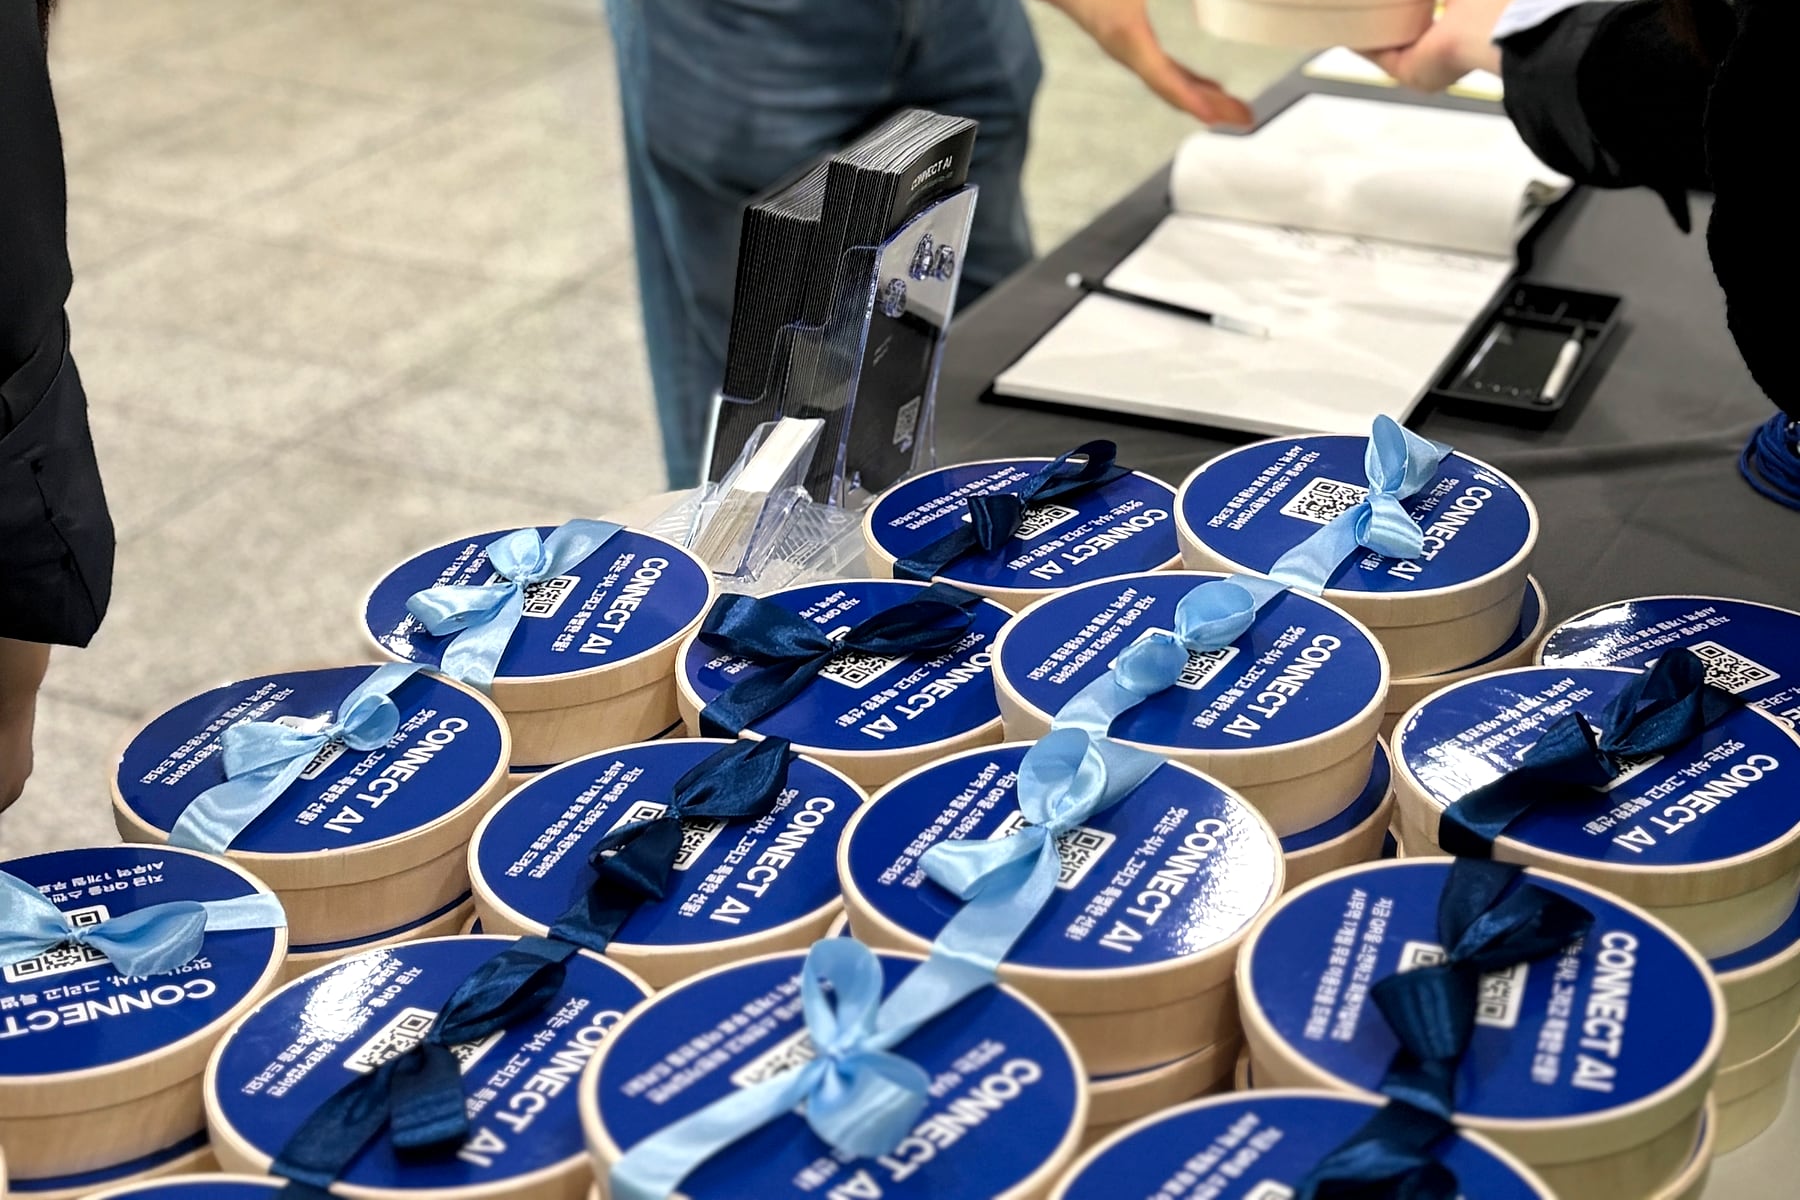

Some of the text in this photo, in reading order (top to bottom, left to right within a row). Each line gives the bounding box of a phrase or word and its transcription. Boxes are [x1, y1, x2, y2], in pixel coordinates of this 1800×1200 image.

[1285, 462, 1307, 477] QR을
[1030, 509, 1168, 580] CONNECT AI
[1060, 525, 1093, 541] 그리고
[464, 558, 485, 573] QR을
[1389, 557, 1424, 577] AI
[579, 558, 669, 654] CONNECT AI
[582, 589, 607, 610] 그리고
[814, 609, 841, 623] QR을
[1116, 609, 1141, 626] QR을
[1679, 623, 1709, 635] QR을
[894, 668, 929, 689] 그리고
[1223, 635, 1341, 738] CONNECT AI
[1235, 665, 1266, 688] 그리고
[1541, 699, 1573, 714] QR을
[860, 715, 897, 739] AI
[350, 749, 385, 776] 그리고
[324, 718, 468, 833] CONNECT AI
[1645, 776, 1685, 799] 그리고
[601, 782, 628, 802] QR을
[977, 788, 1005, 809] QR을
[1613, 755, 1779, 853] CONNECT AI
[724, 836, 757, 864] 그리고
[737, 797, 835, 898] CONNECT
[1111, 856, 1146, 887] 그리고
[89, 882, 128, 895] QR을
[1099, 817, 1226, 953] CONNECT AI
[710, 895, 750, 924] AI
[43, 980, 99, 1000] 그리고
[360, 985, 402, 1008] QR을
[1547, 982, 1574, 1017] 그리고
[0, 979, 216, 1038] CONNECT
[1572, 931, 1636, 1091] CONNECT AI
[488, 1053, 530, 1088] 그리고
[876, 1058, 1041, 1181] CONNECT
[459, 1129, 508, 1164] AI
